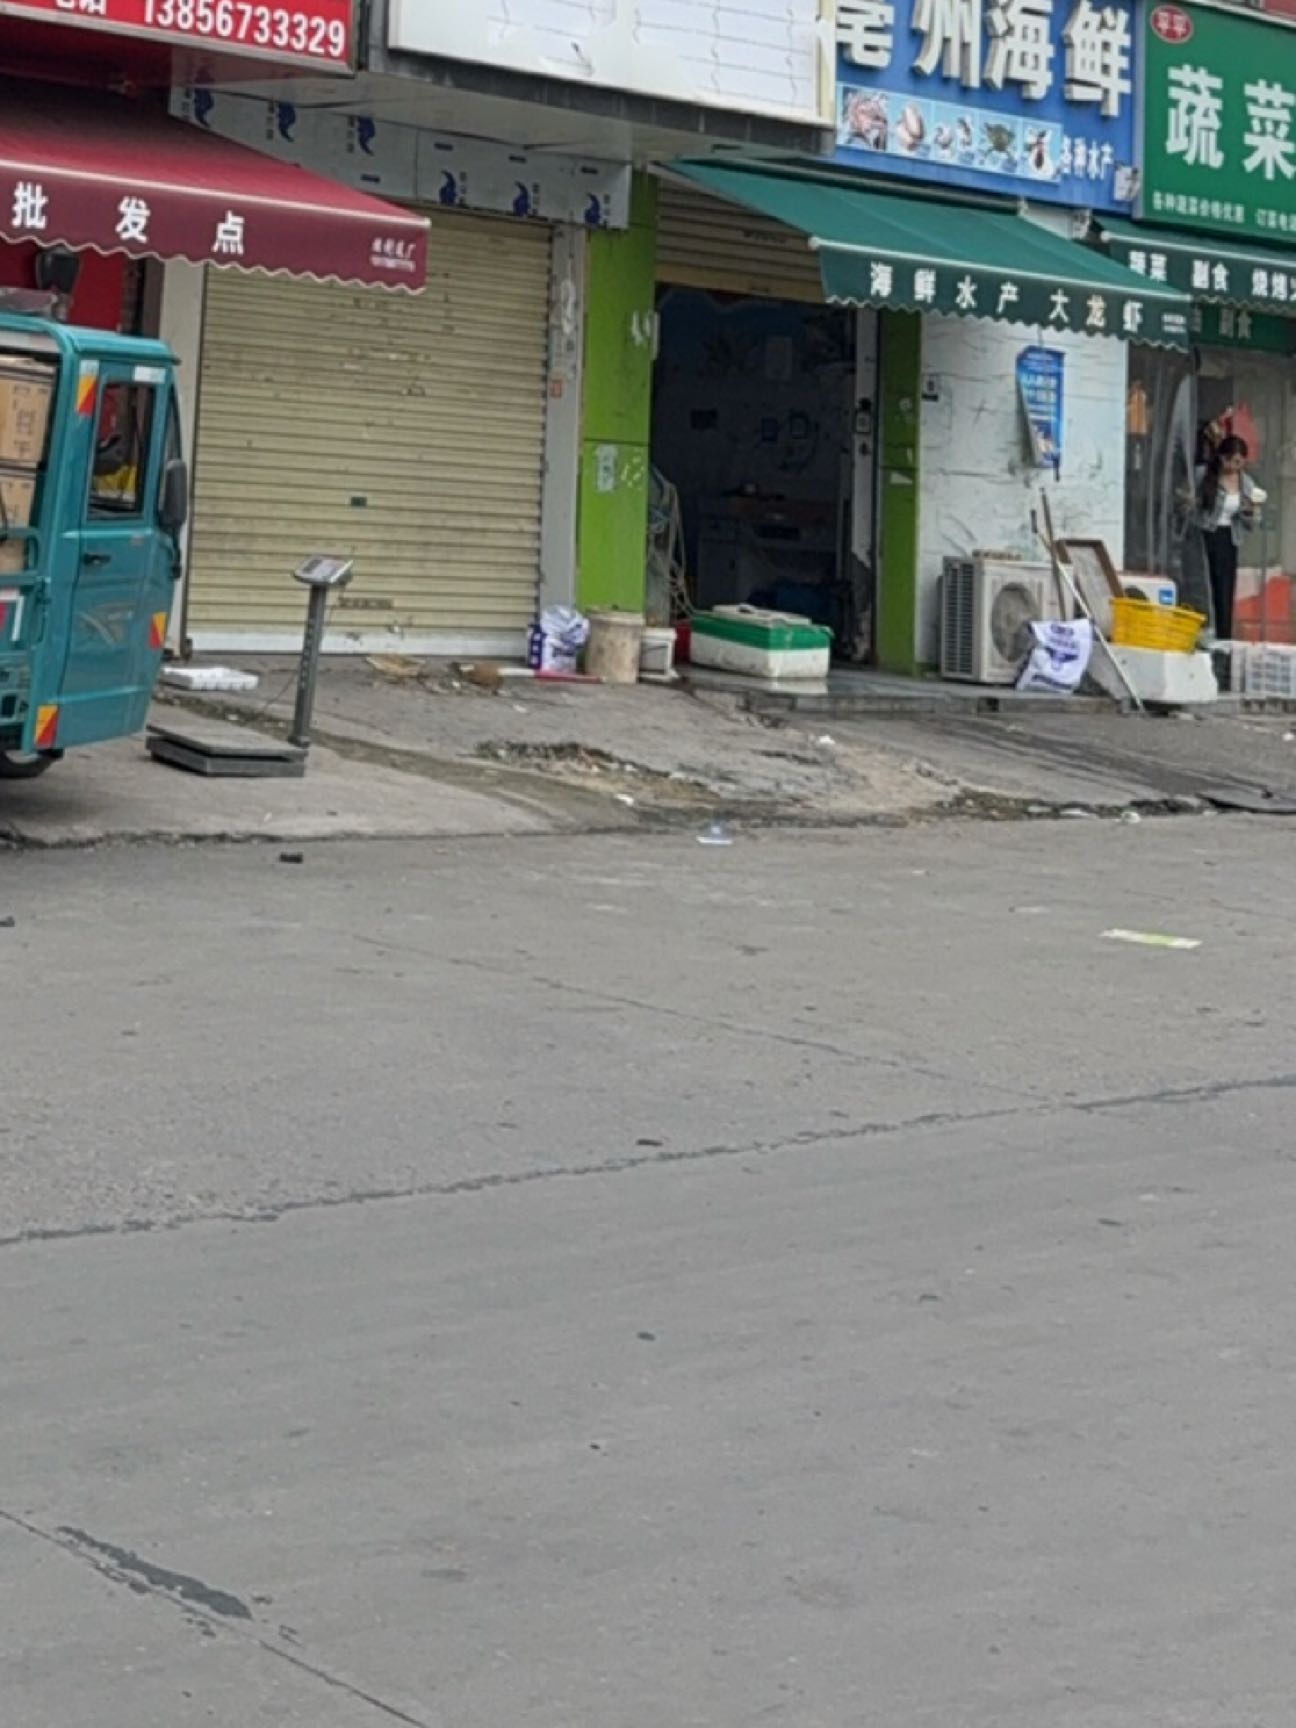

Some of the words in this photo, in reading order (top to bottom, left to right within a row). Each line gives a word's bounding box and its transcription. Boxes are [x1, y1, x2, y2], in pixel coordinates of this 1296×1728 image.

[1165, 63, 1296, 182] 蔬菜
[869, 261, 1144, 334] 海鲜水产大龙虾
[1191, 259, 1229, 292] 副食
